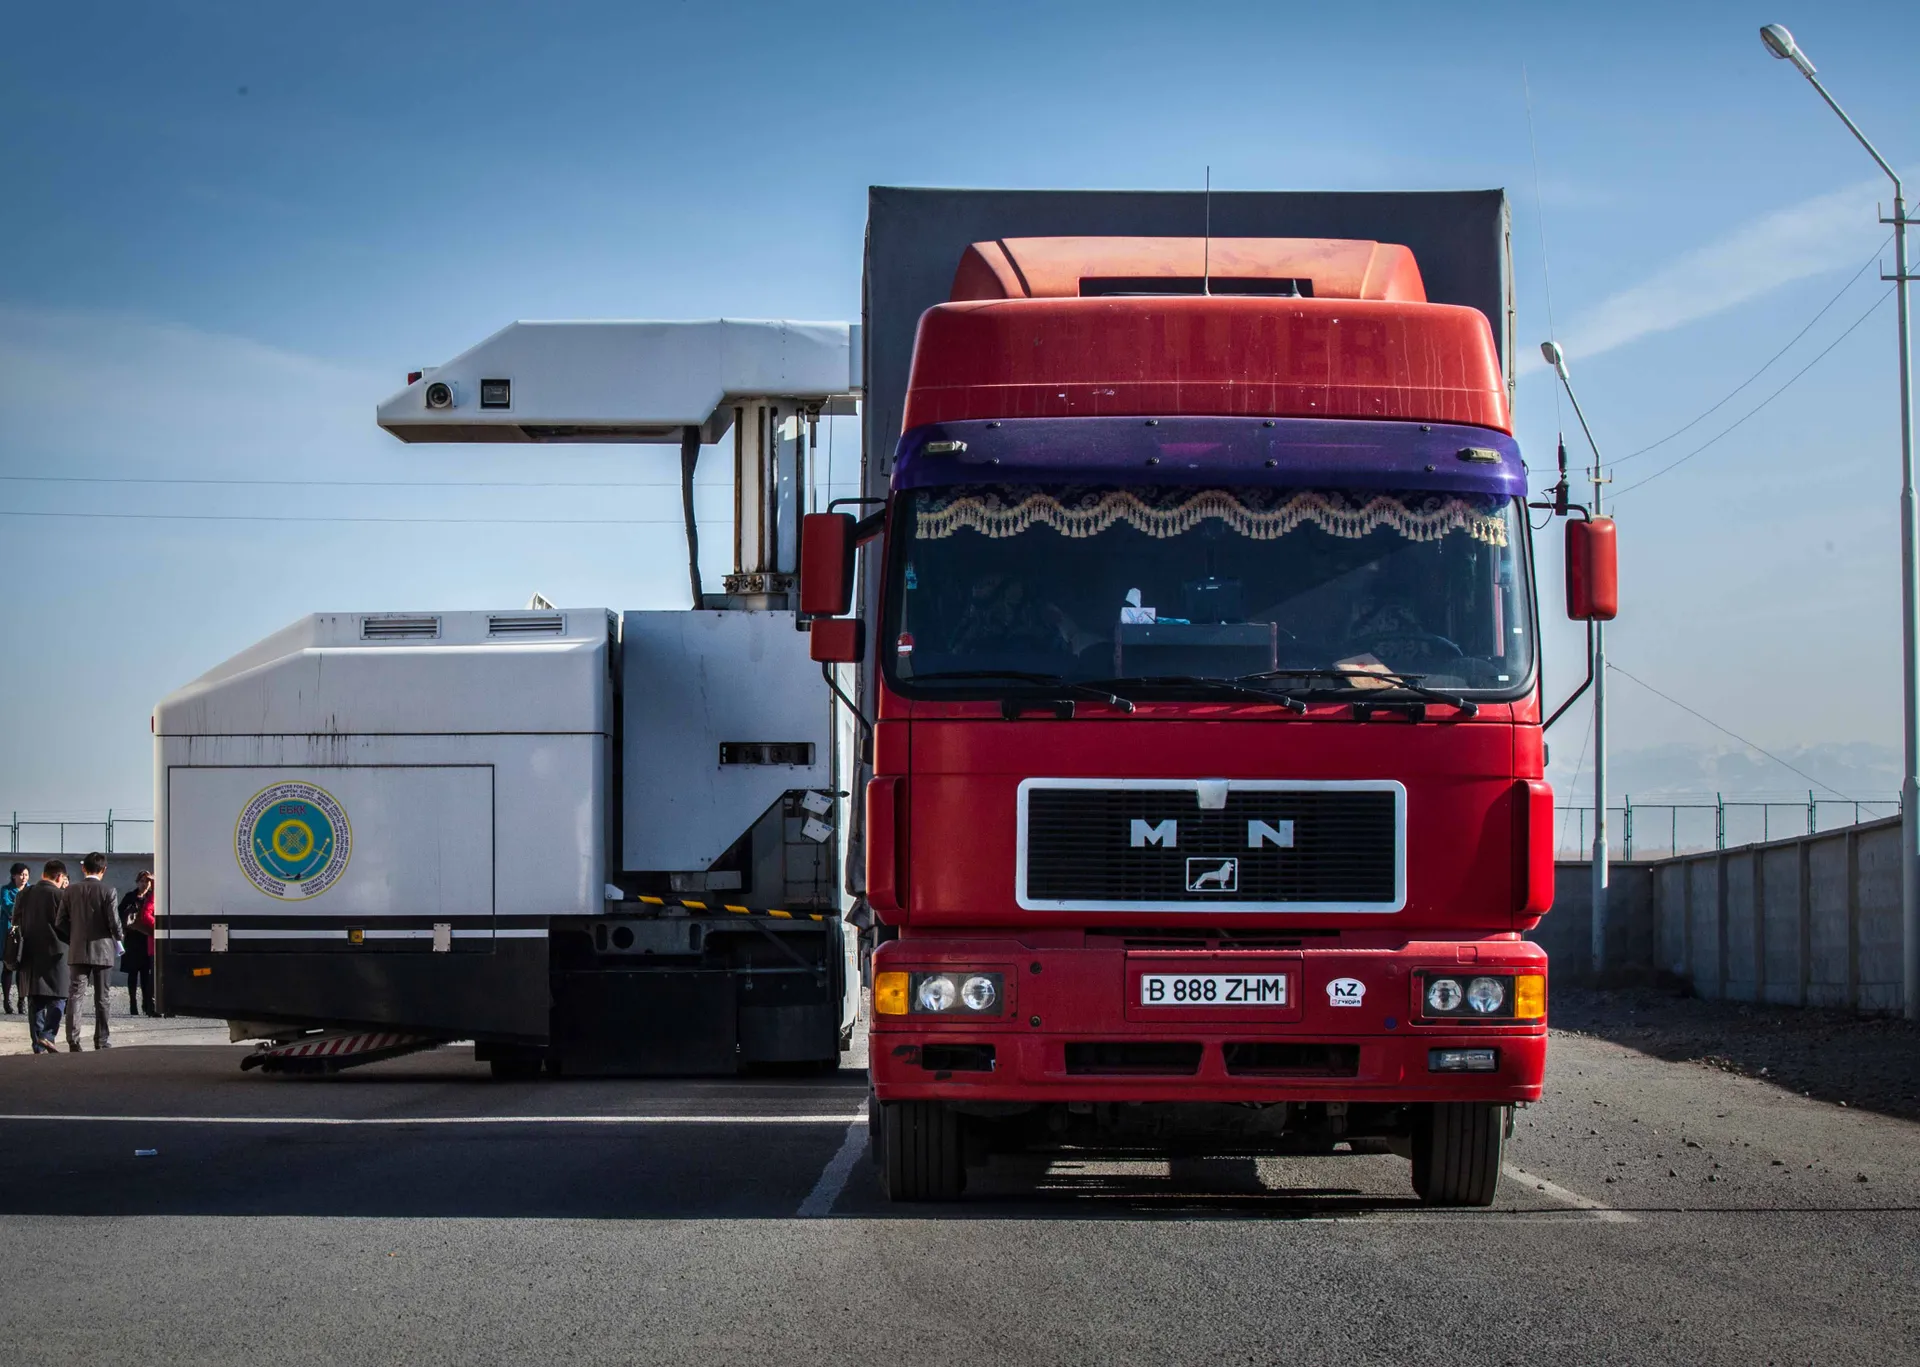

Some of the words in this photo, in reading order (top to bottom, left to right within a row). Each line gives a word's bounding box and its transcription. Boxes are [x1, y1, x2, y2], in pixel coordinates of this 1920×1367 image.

[1149, 978, 1165, 1002] B
[1173, 978, 1217, 1002] 888
[1225, 978, 1279, 1002] ZHM
